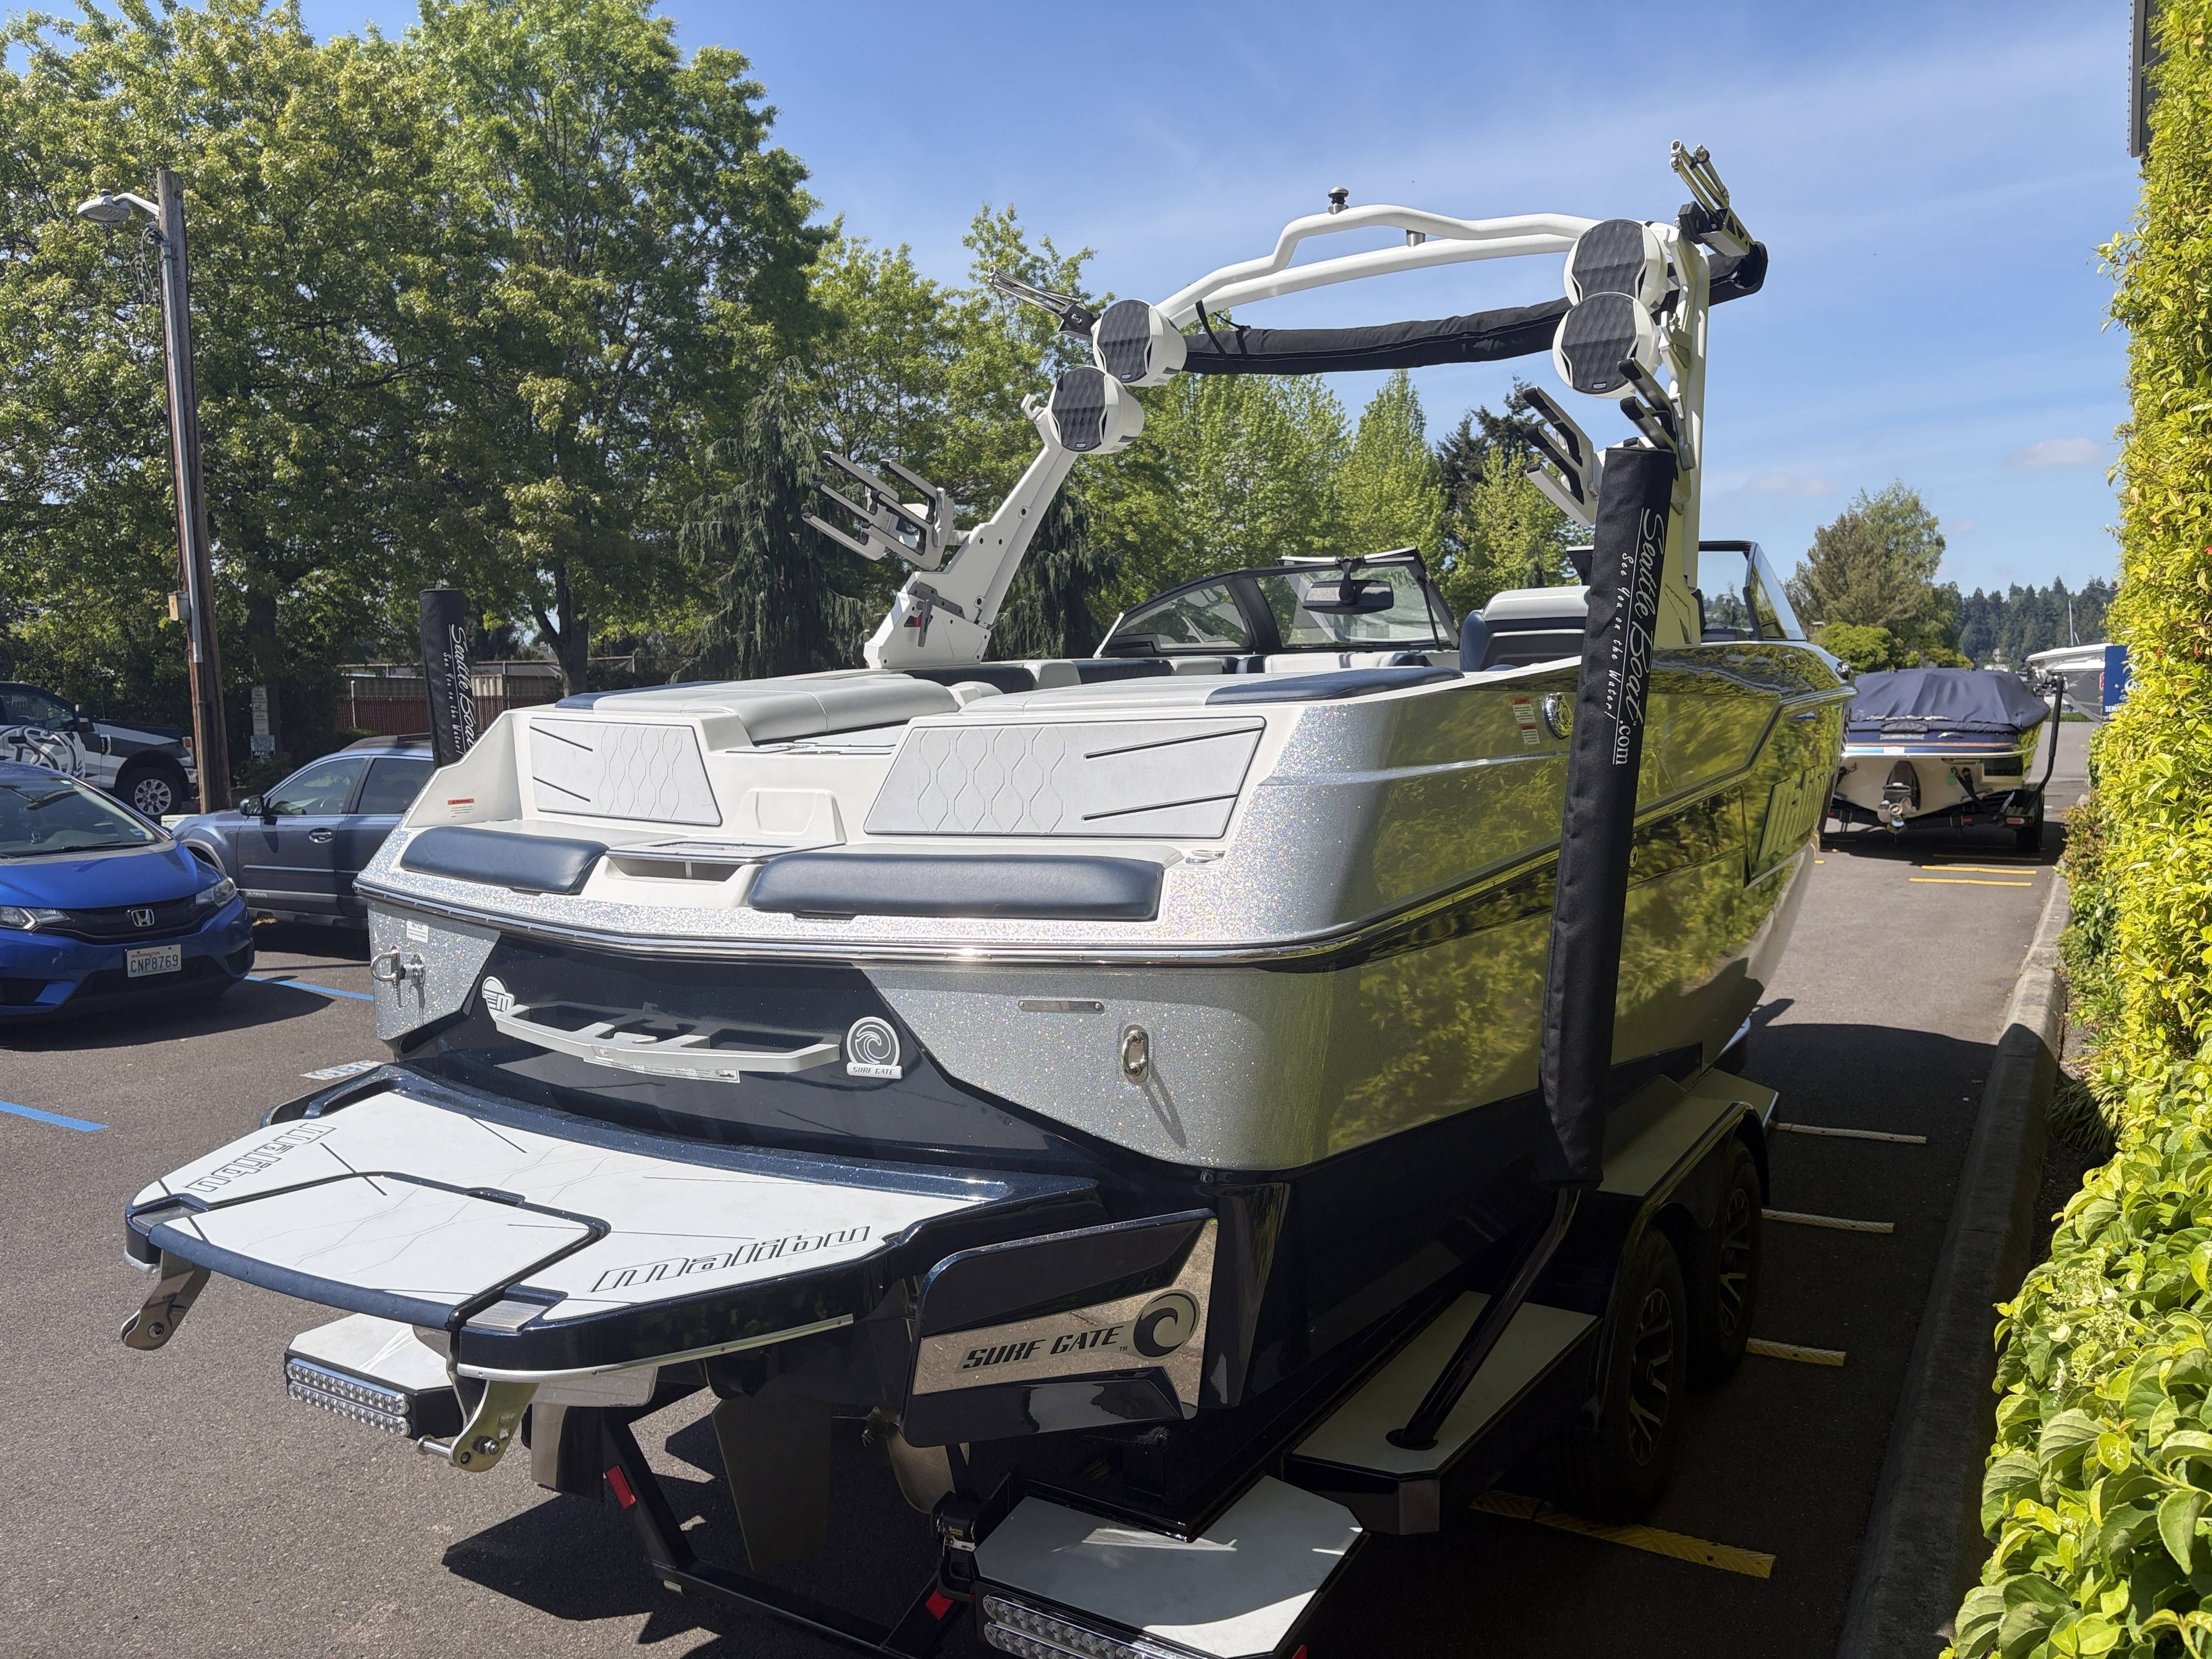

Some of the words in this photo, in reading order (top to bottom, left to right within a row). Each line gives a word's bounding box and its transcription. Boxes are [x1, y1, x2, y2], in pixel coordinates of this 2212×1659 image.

[1620, 552, 1634, 576] See
[1634, 508, 1664, 619] Seattle
[1613, 617, 1622, 630] on
[443, 652, 452, 667] See
[451, 624, 471, 691] Seattle
[1611, 639, 1624, 660] the
[1604, 669, 1622, 720] Water!
[450, 706, 459, 719] the
[452, 724, 462, 754] Water!
[131, 953, 179, 973] CNP8769
[874, 1068, 895, 1076] GATE
[588, 1226, 871, 1293] malibu
[962, 1339, 1047, 1369] SURF
[1049, 1325, 1125, 1355] GATE
